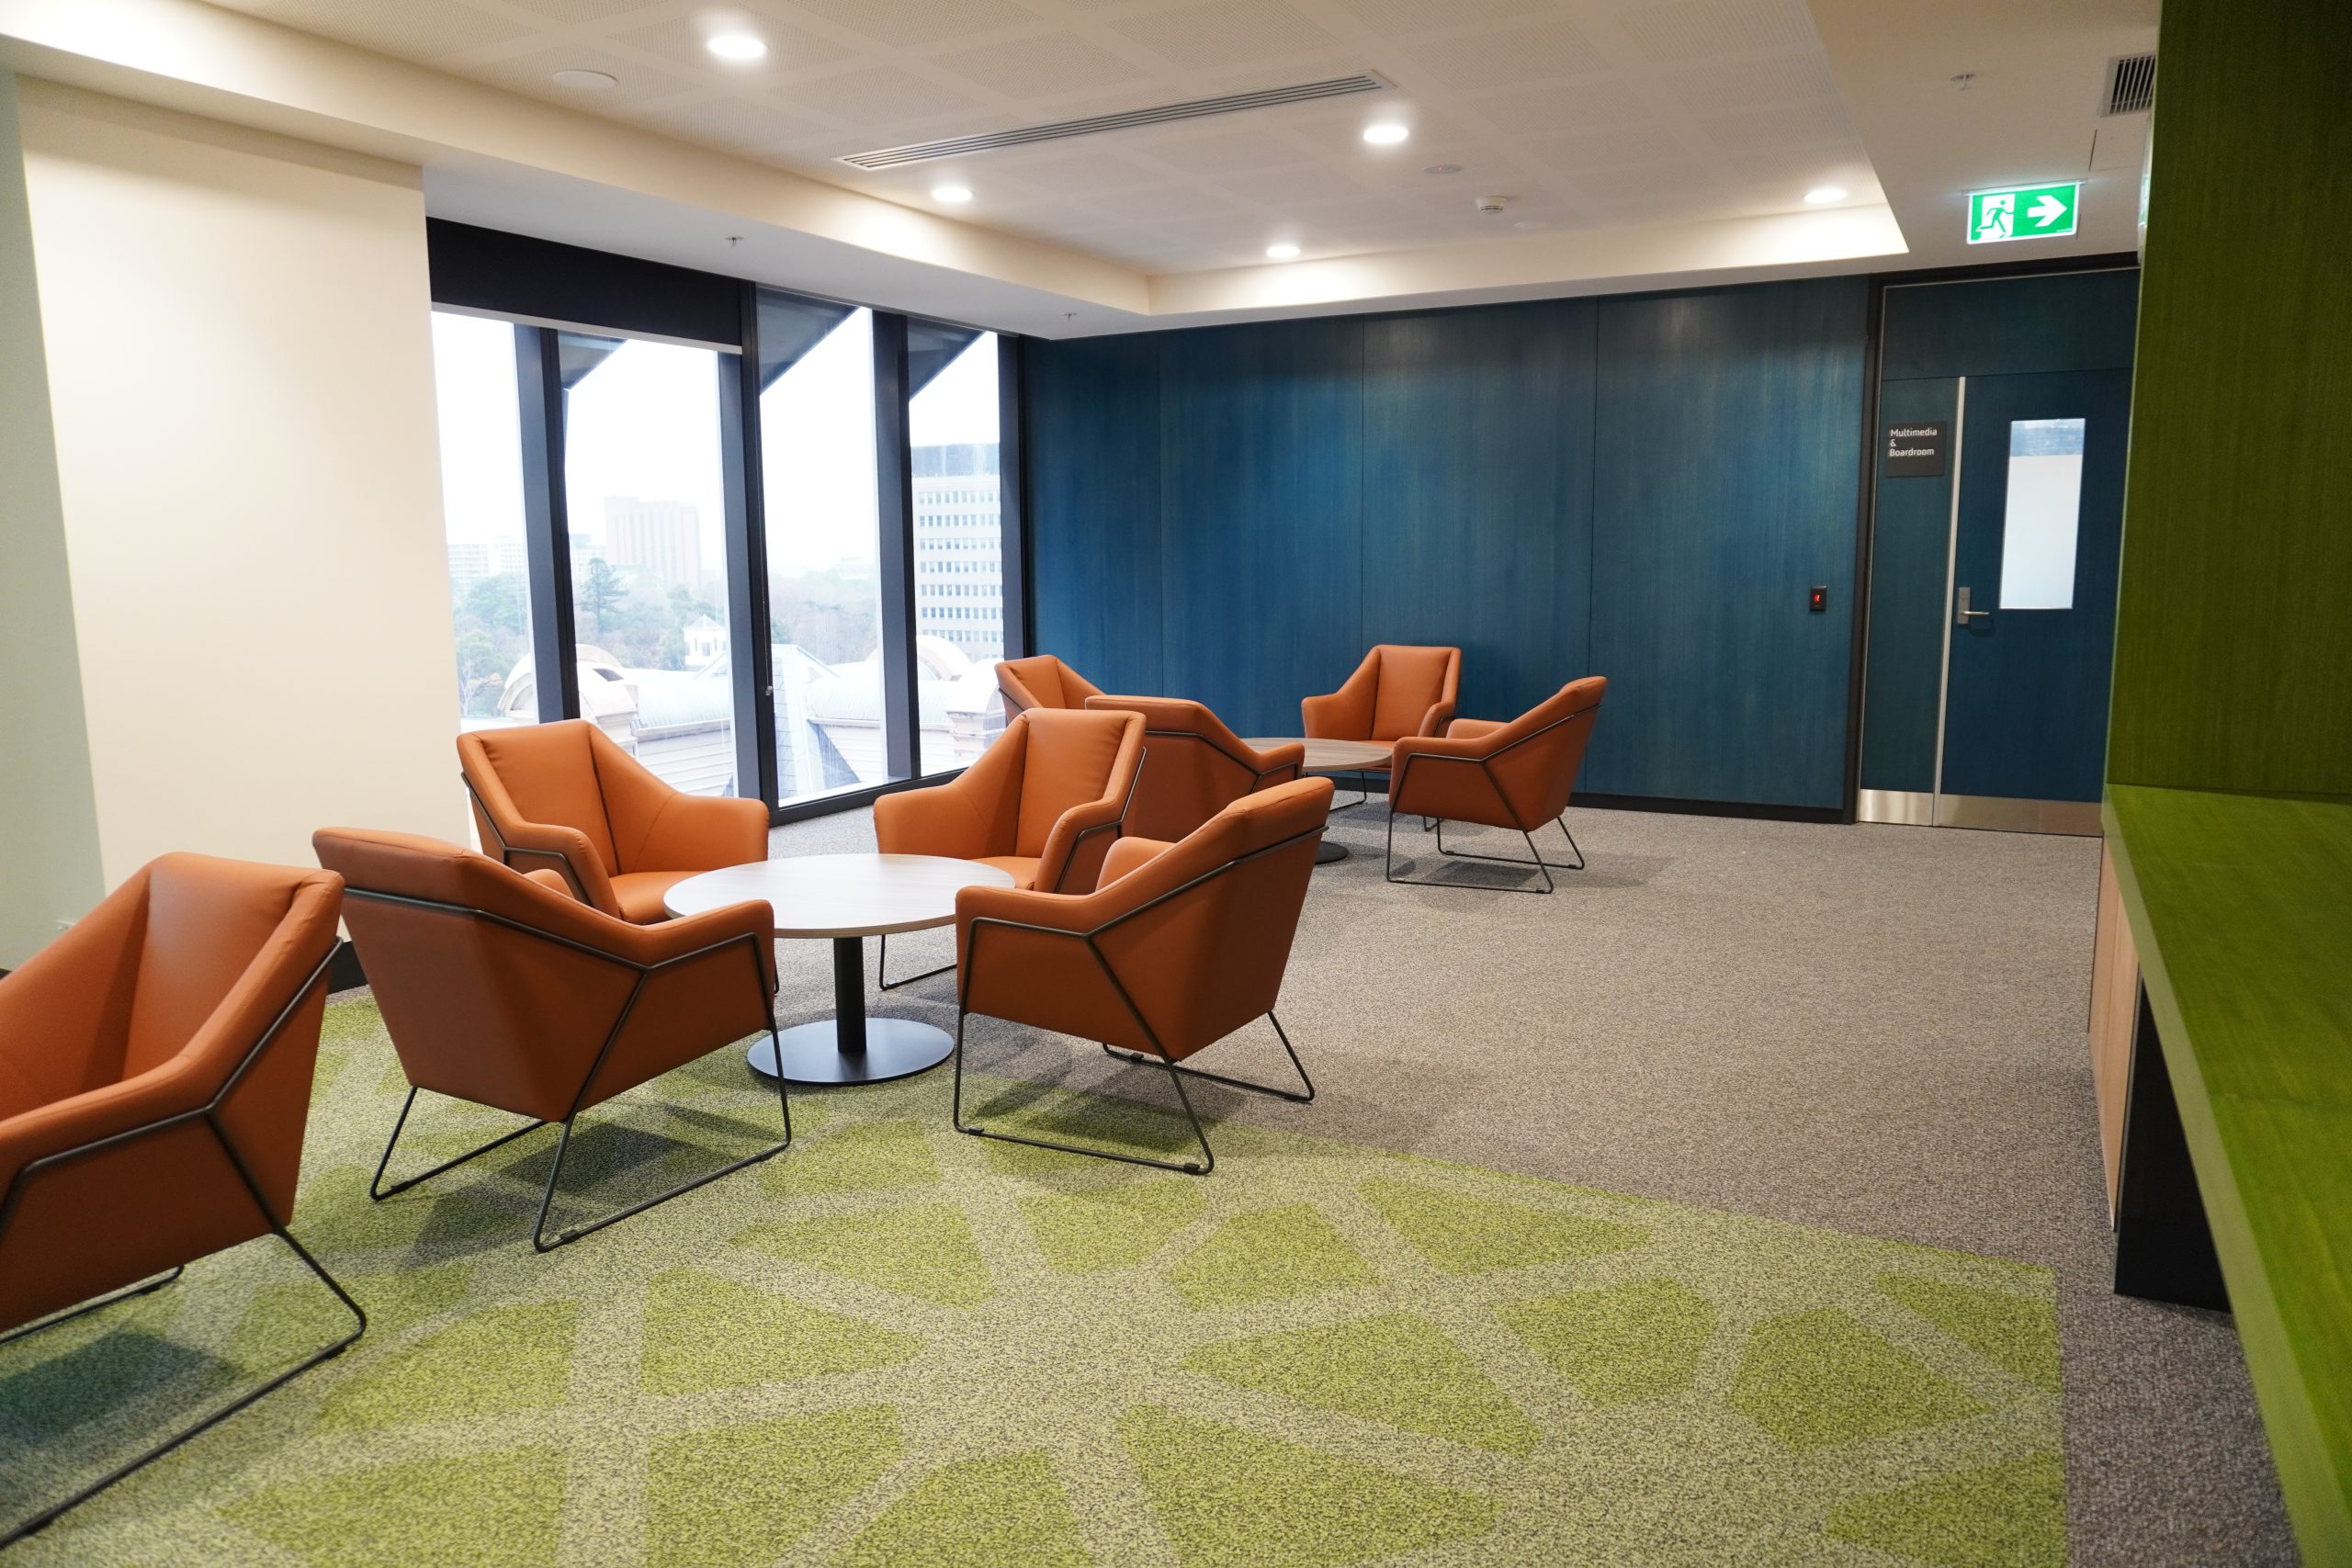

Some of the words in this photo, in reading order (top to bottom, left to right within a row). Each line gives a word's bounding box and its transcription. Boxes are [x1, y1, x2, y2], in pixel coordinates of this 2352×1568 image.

[1890, 427, 1938, 437] Multimedia
[1890, 439, 1896, 447] &
[1889, 448, 1935, 457] Boardroom
